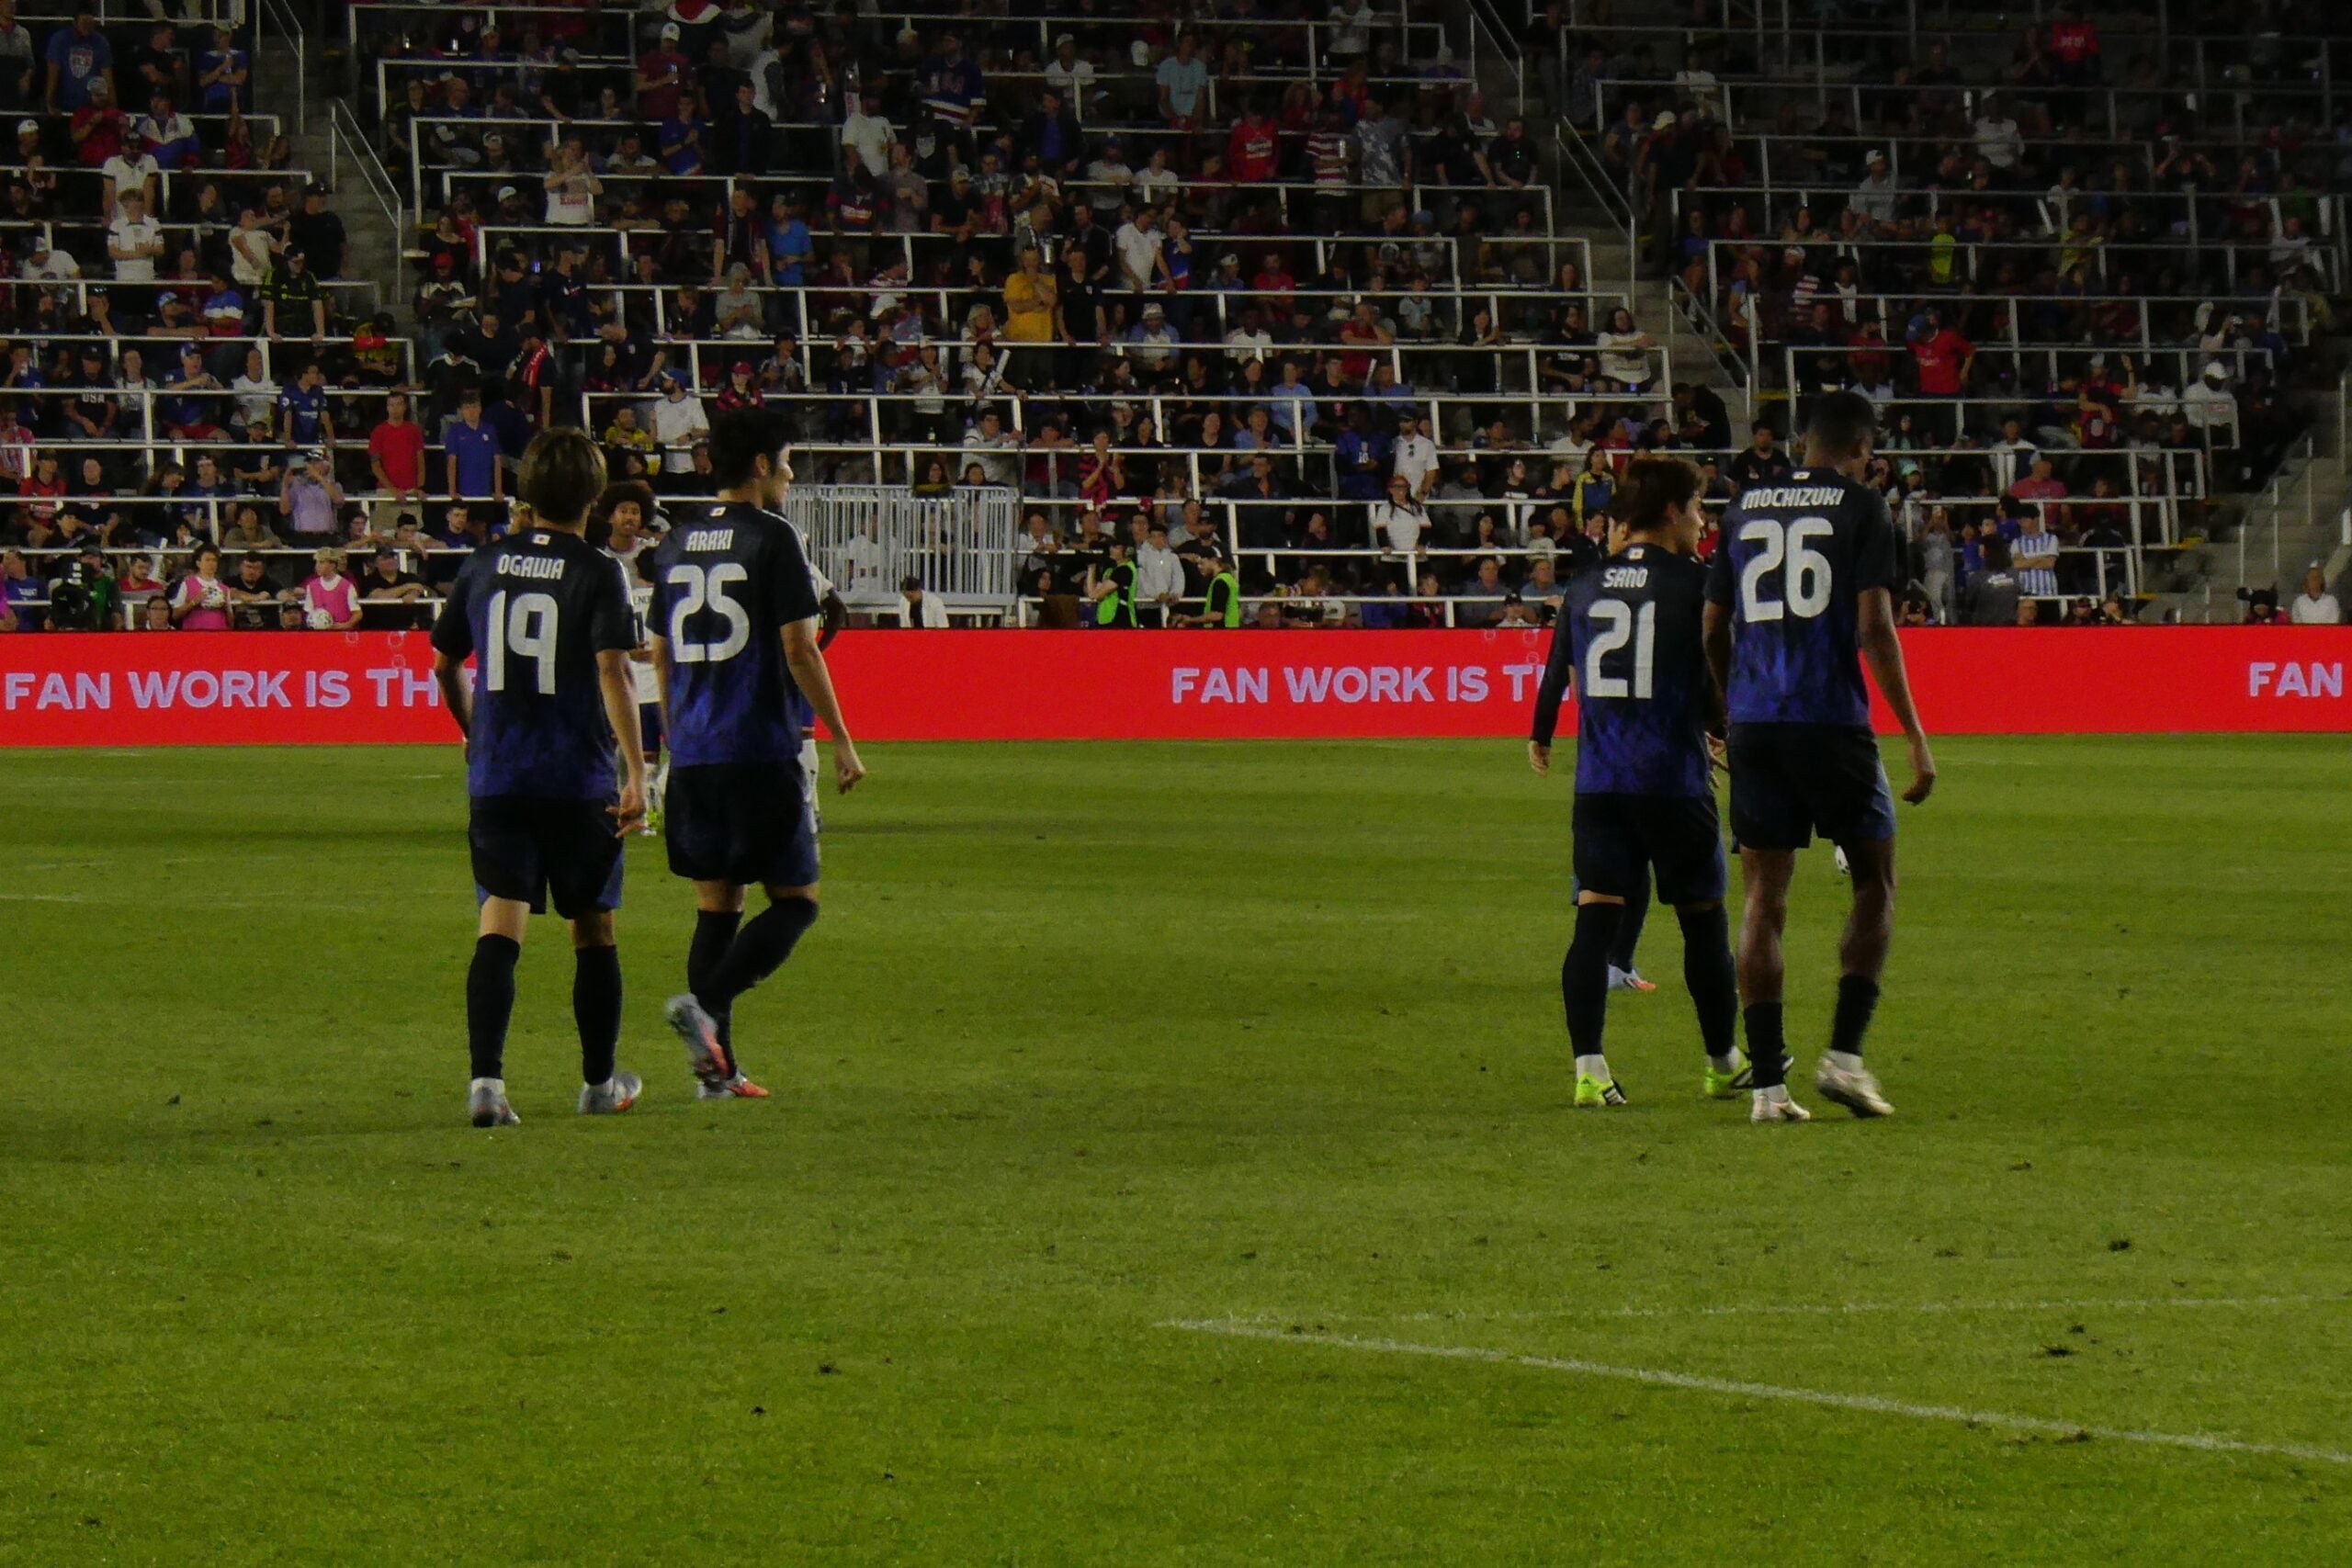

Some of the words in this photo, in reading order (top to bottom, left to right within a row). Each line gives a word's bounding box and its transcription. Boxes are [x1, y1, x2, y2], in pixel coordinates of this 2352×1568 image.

[1740, 487, 1844, 511] MOCHIZUKI
[684, 529, 734, 552] ARAKI
[496, 554, 565, 580] OGAWA
[1602, 568, 1648, 589] SANO
[1738, 517, 1834, 623] 26
[667, 563, 750, 662] 25
[487, 590, 559, 694] 19
[1586, 599, 1656, 699] 21
[5, 671, 111, 710] FAN
[128, 670, 292, 708] WORK
[306, 670, 351, 707] IS
[366, 668, 478, 706] TH
[1172, 668, 1269, 703] FAN
[1283, 666, 1435, 703] WORK
[1447, 666, 1489, 702] IS
[2249, 661, 2343, 697] FAN
